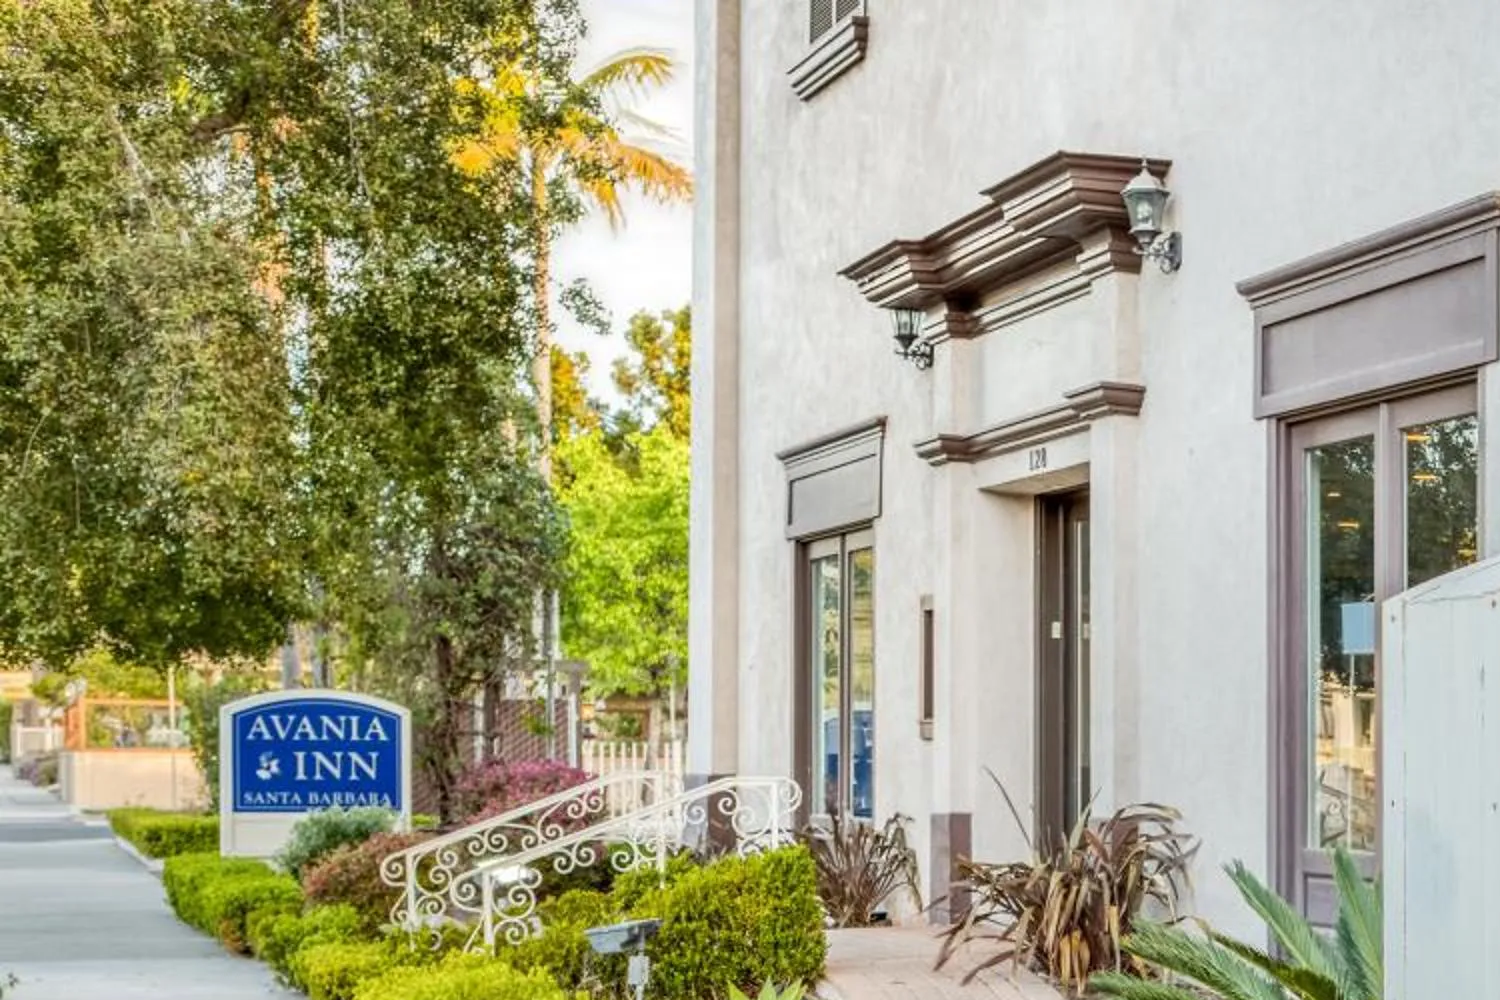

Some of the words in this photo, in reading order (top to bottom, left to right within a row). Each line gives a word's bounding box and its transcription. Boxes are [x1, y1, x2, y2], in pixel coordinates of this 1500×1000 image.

[246, 714, 389, 742] AVANIA
[293, 751, 381, 781] INN
[243, 792, 302, 806] SANTA
[308, 791, 392, 807] BARBARA
